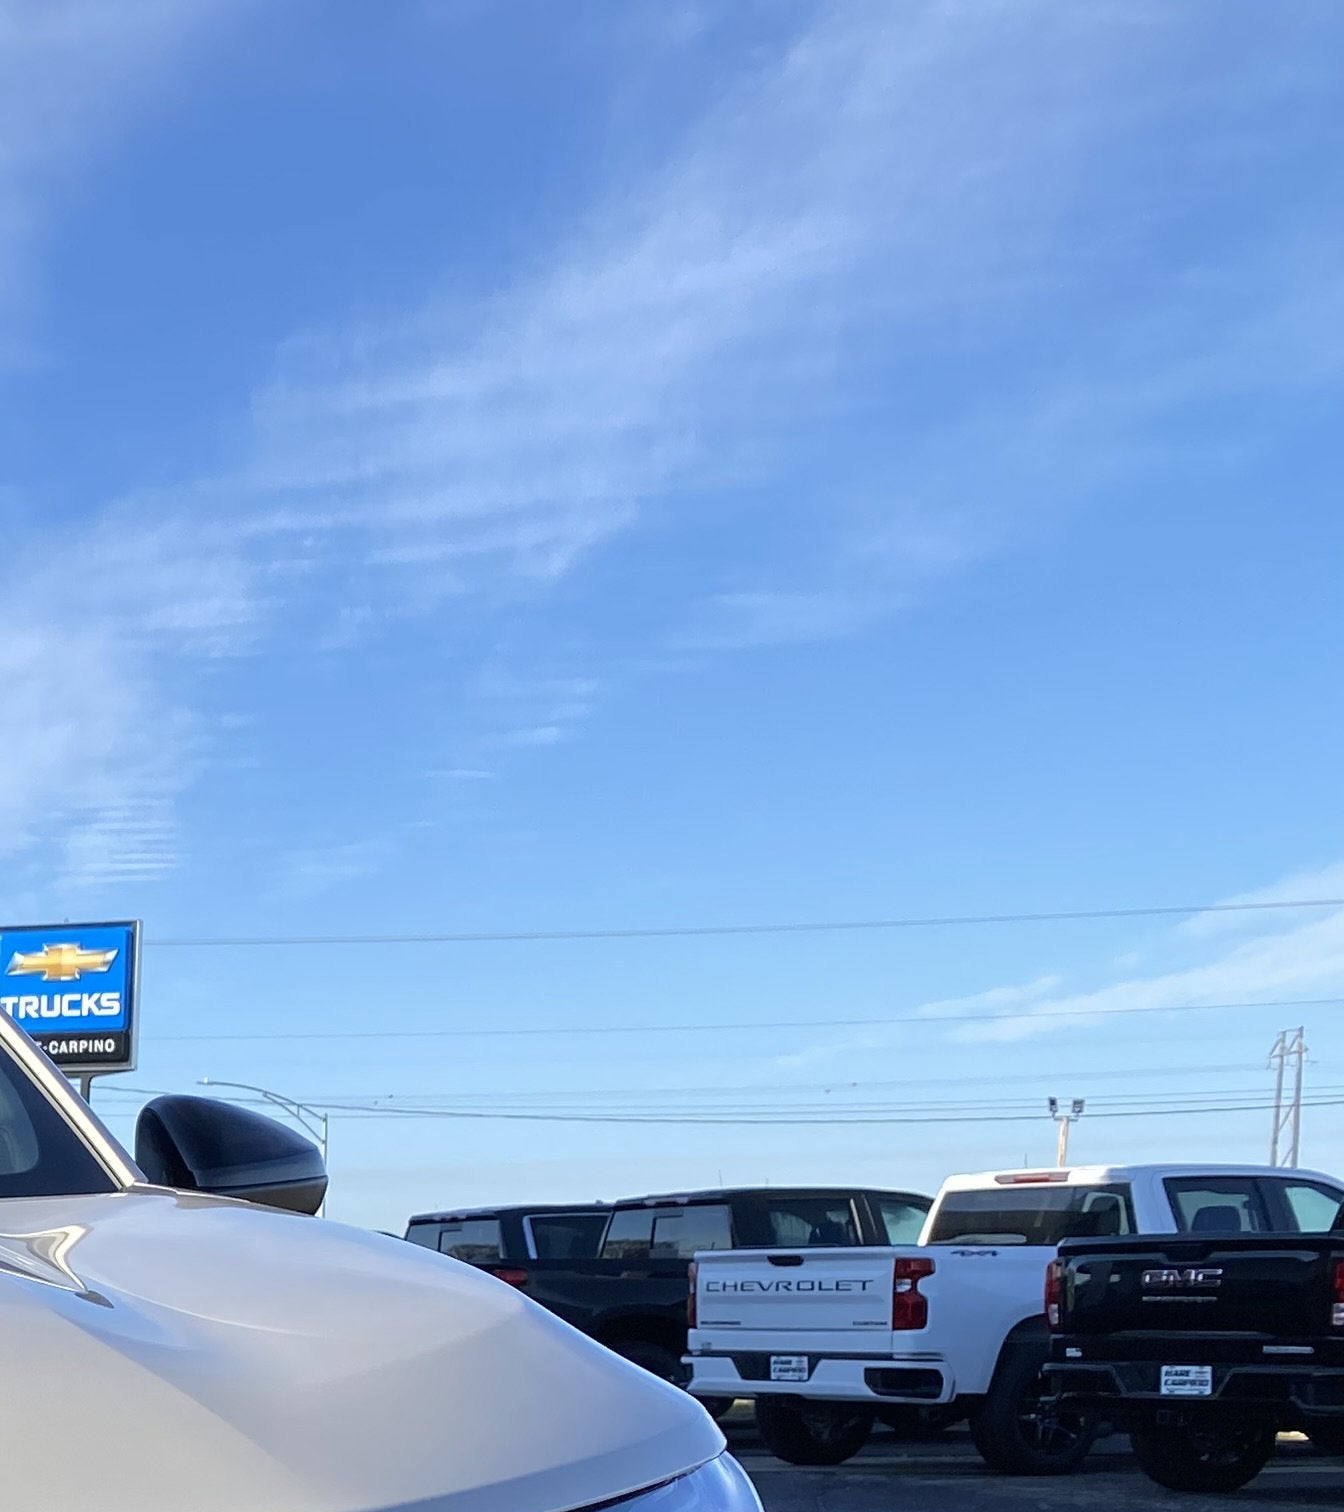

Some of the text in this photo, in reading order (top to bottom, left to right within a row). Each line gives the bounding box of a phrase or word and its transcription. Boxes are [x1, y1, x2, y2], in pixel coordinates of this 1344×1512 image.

[0, 992, 121, 1019] TRUCKS
[705, 1279, 875, 1293] CHEVROLET
[1142, 1268, 1224, 1288] GMC
